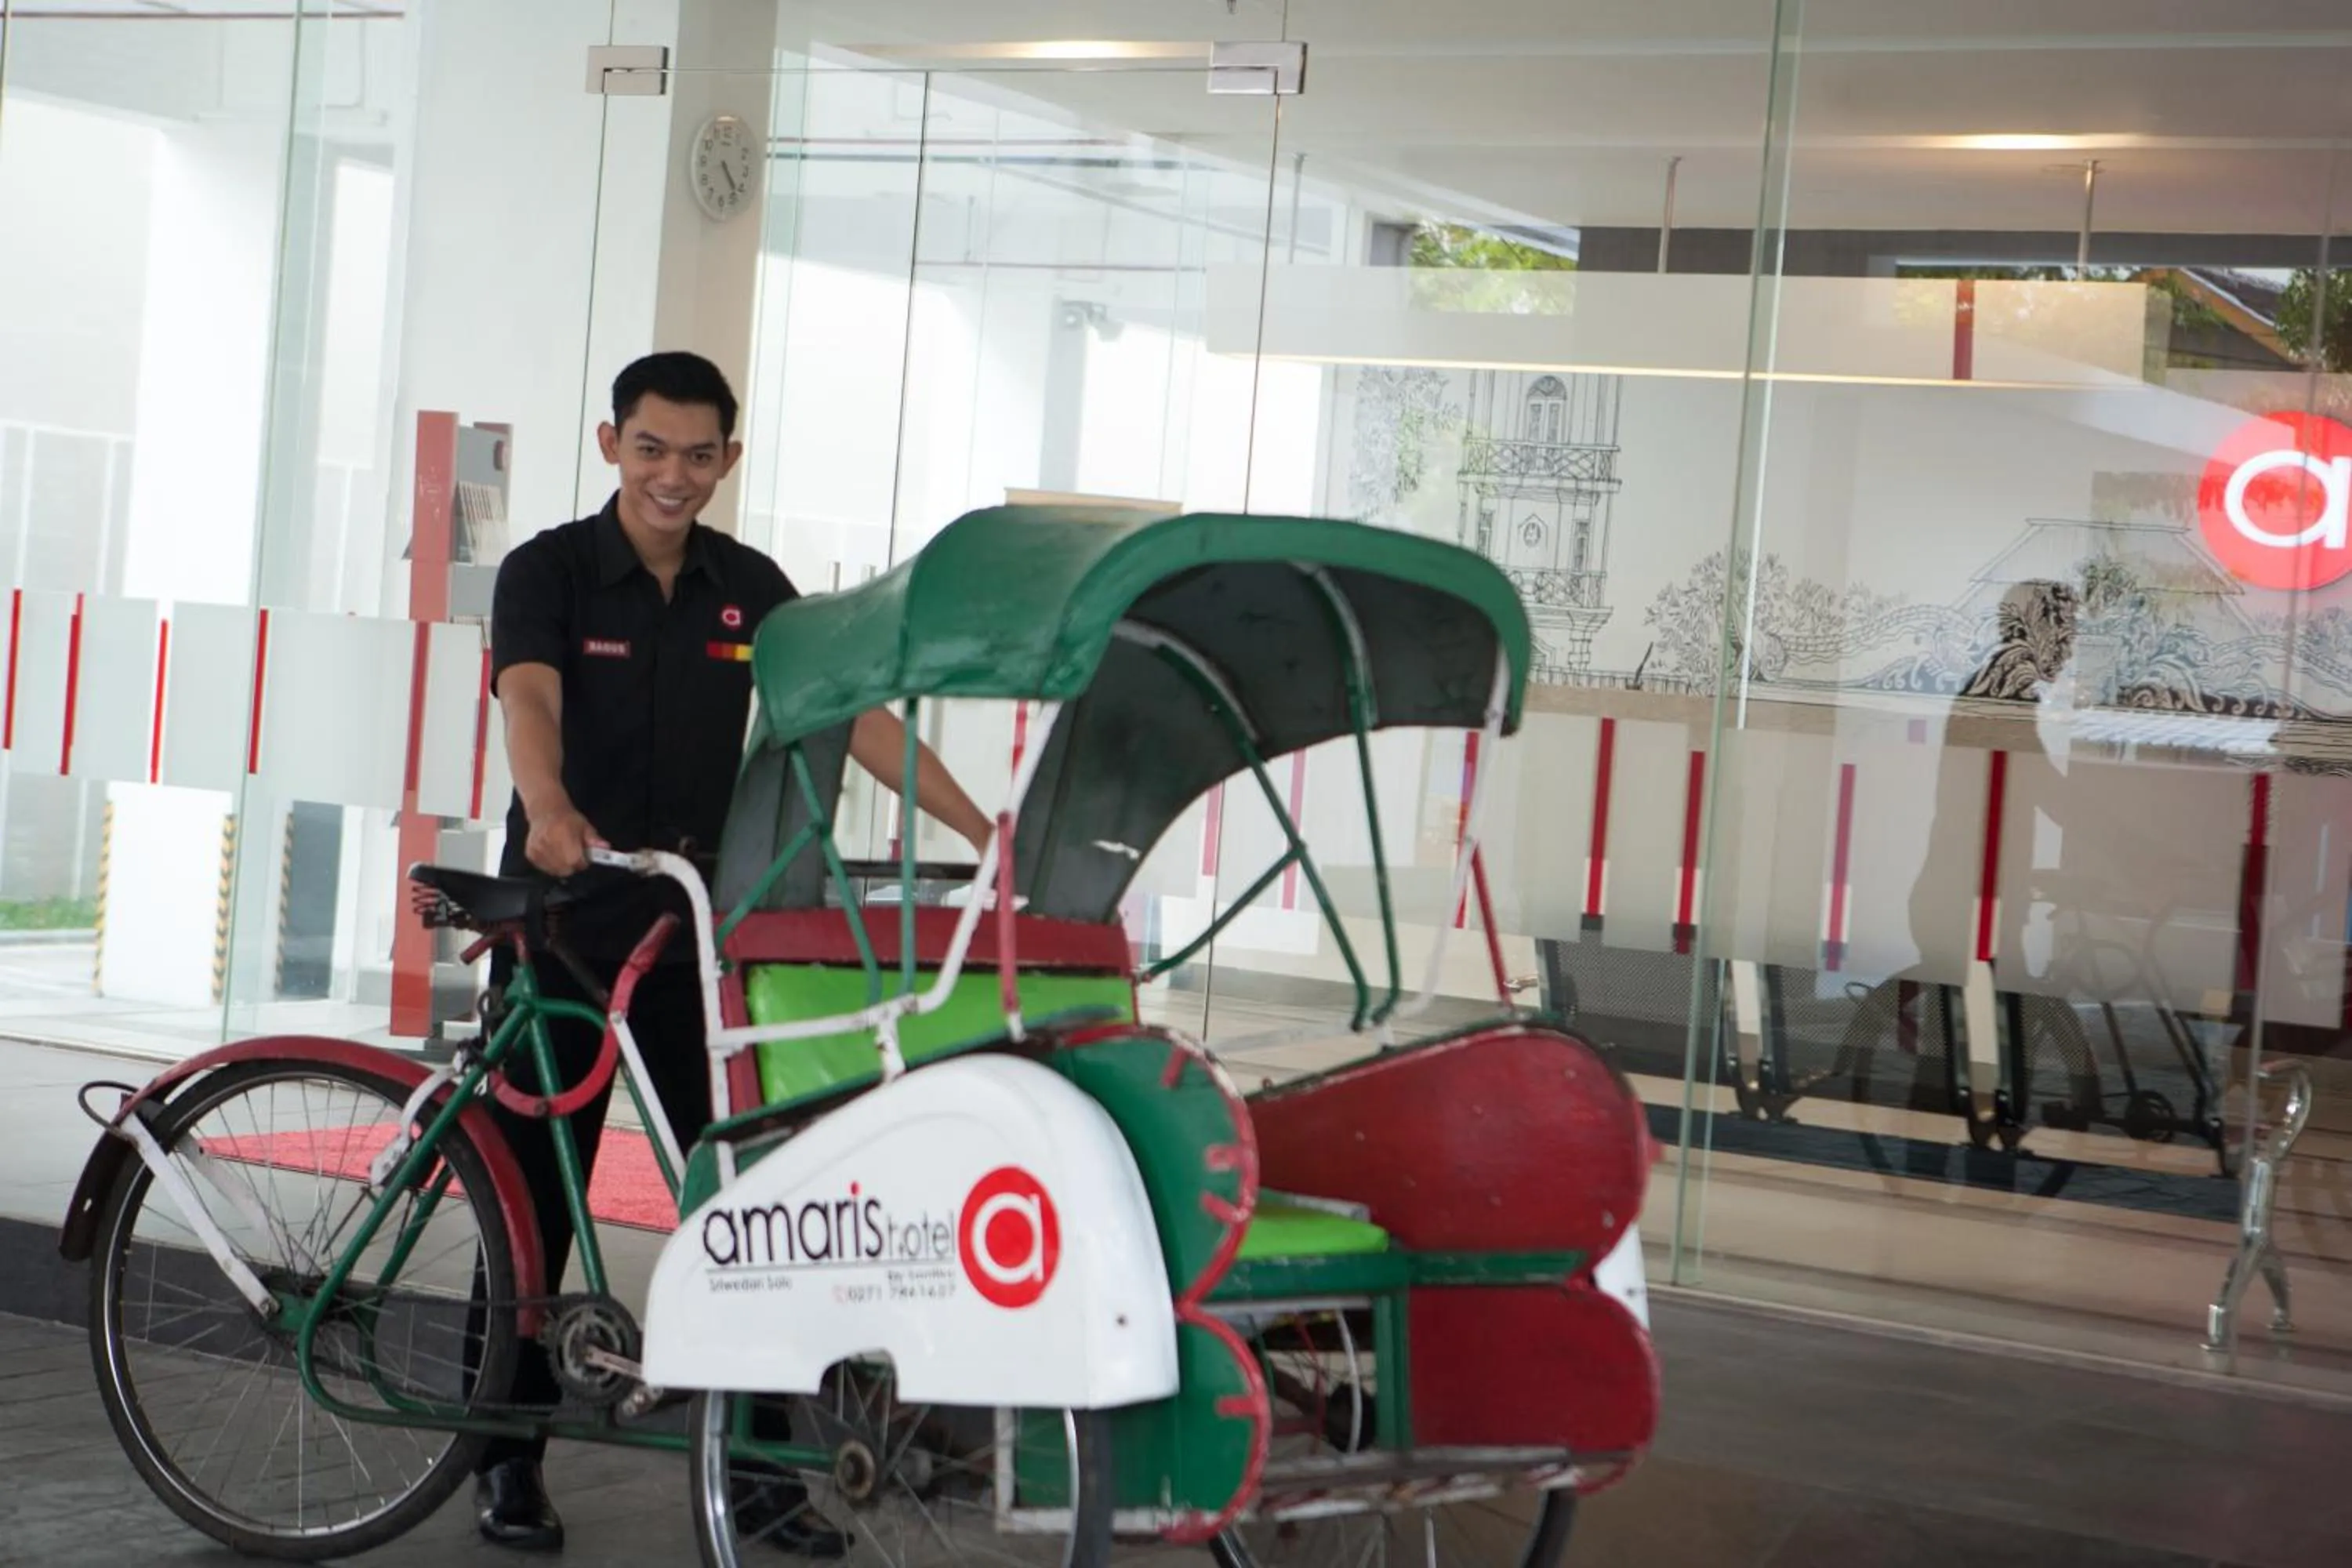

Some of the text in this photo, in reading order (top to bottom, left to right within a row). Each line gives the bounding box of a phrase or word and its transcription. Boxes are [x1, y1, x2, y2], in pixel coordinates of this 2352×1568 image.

[2224, 449, 2351, 549] a
[702, 1181, 883, 1265] amaris
[971, 1192, 1044, 1285] a
